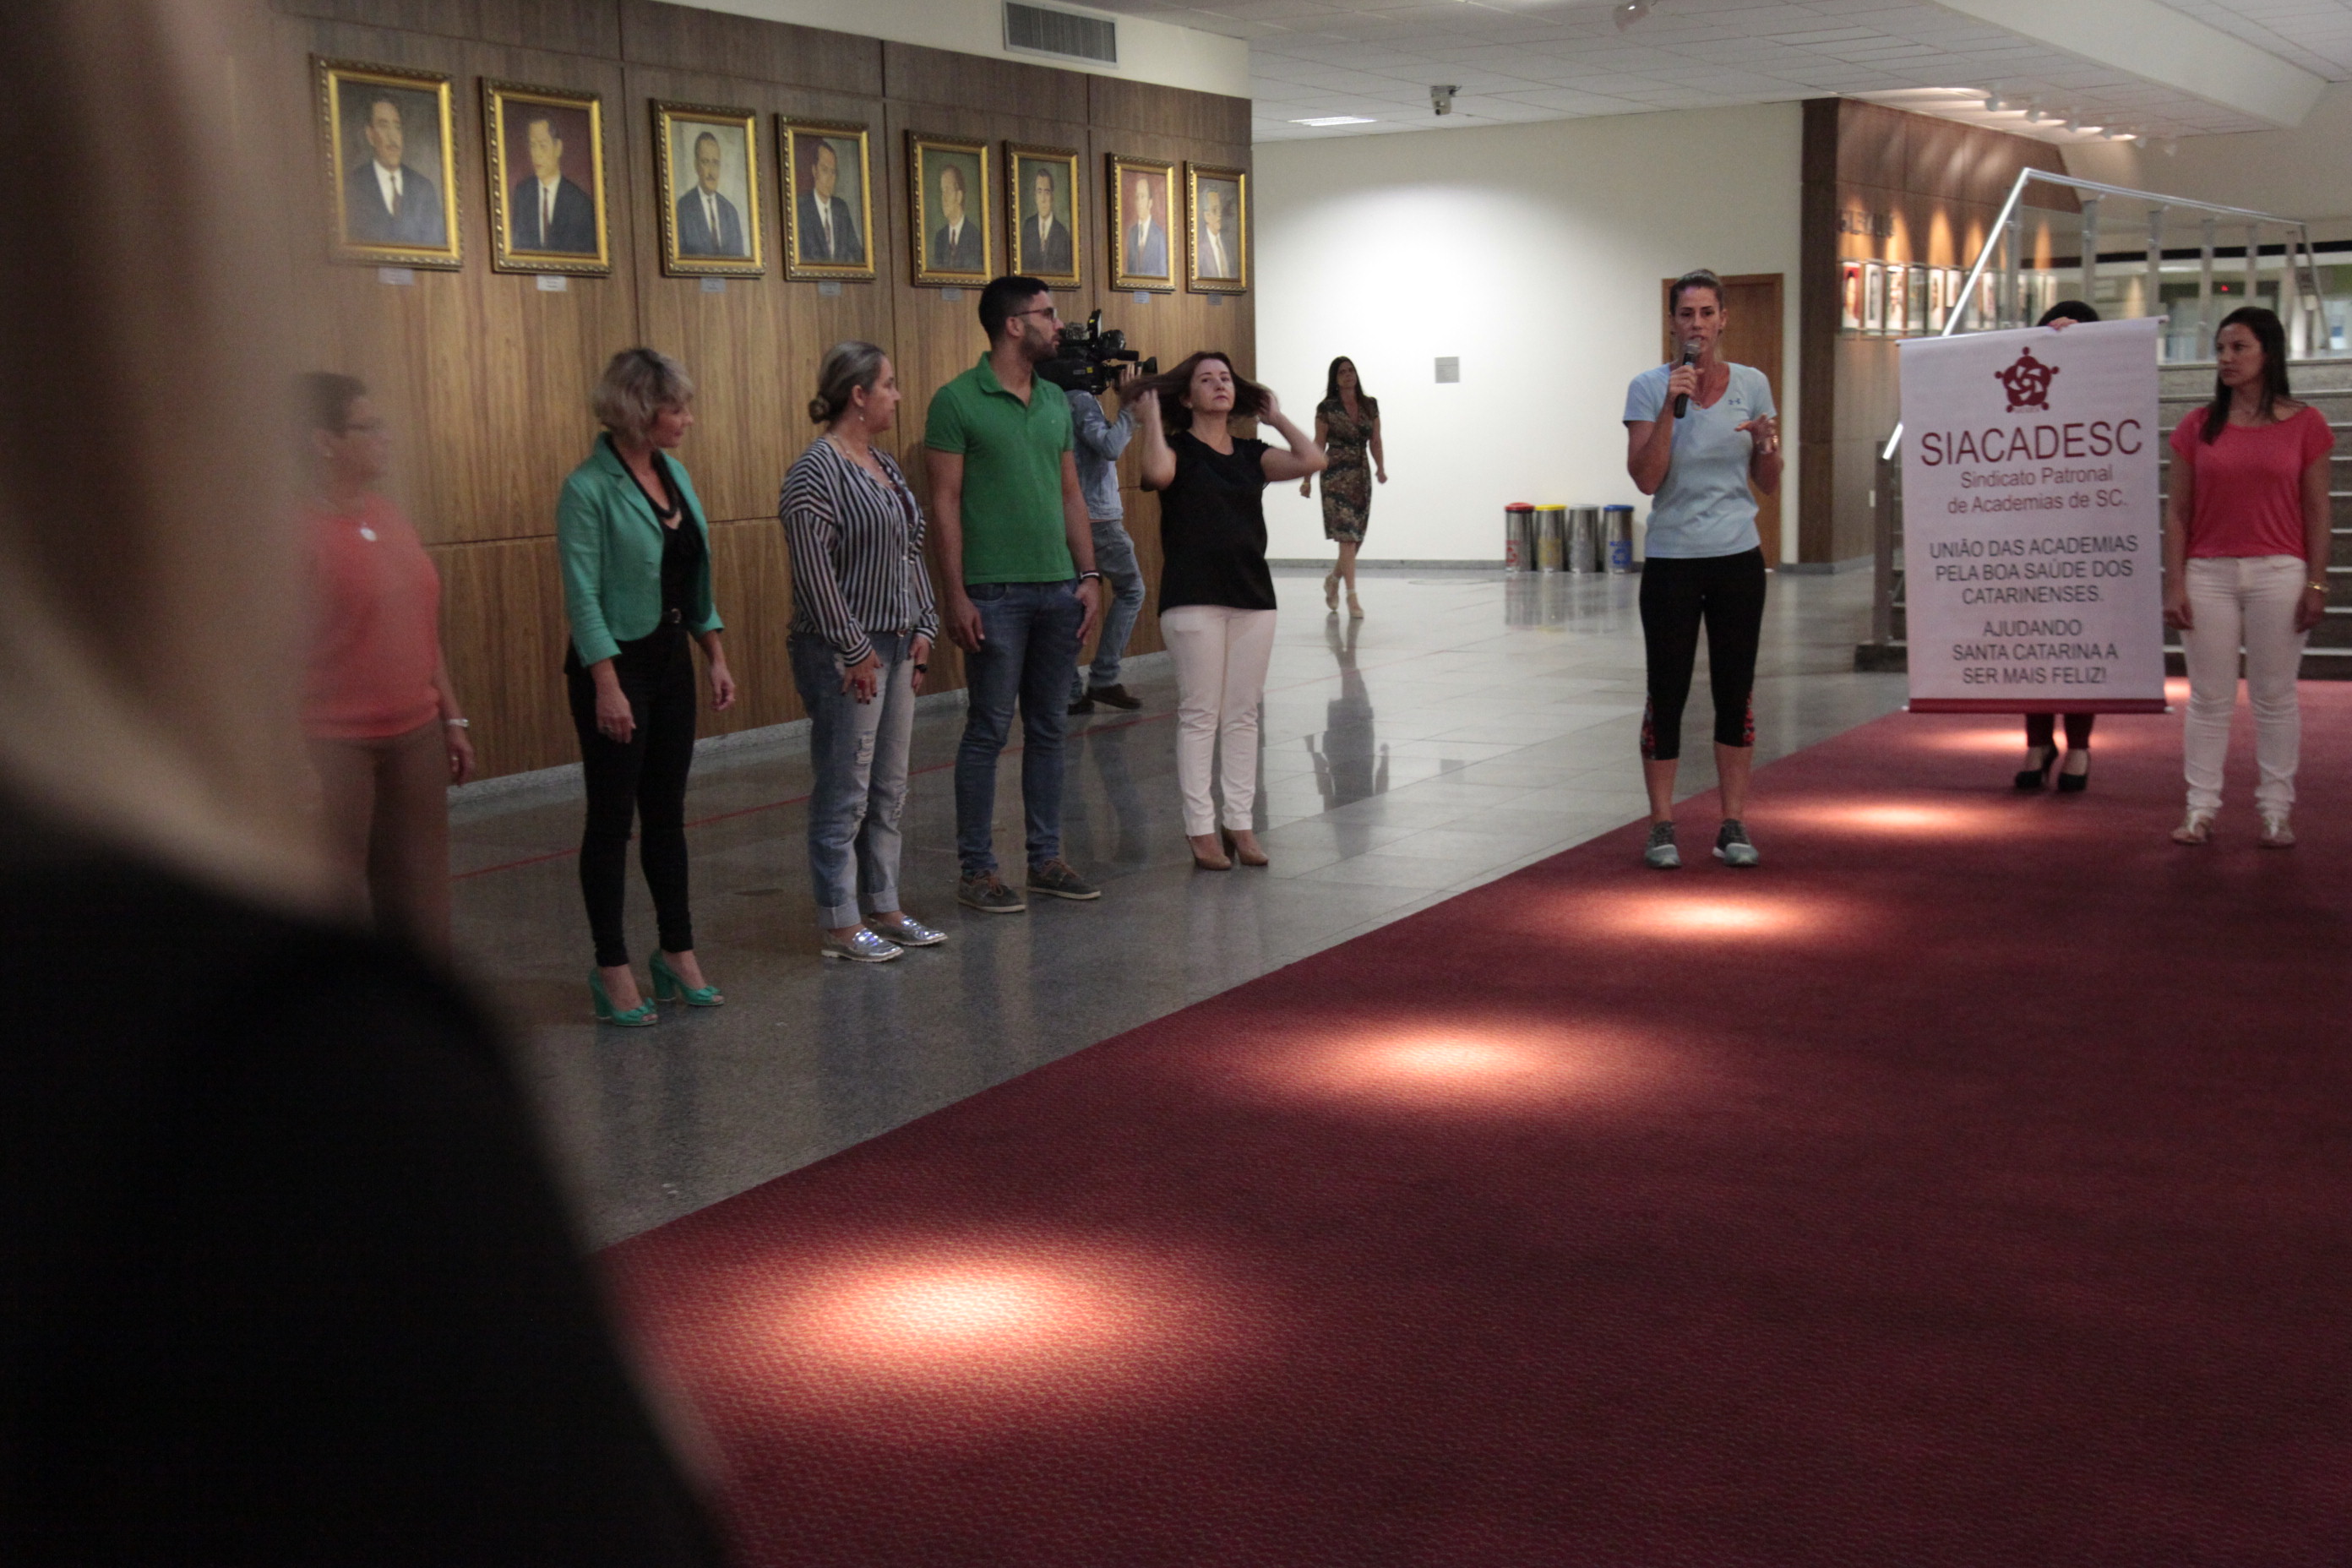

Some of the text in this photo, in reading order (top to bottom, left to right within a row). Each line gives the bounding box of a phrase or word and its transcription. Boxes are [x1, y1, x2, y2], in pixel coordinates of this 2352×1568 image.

[1921, 419, 2142, 466] SIACADESC
[1961, 465, 2113, 489] Sindicato Patronal
[1947, 497, 1968, 514] de
[1972, 493, 2063, 513] Academias
[2069, 491, 2090, 509] de
[1930, 535, 2139, 559] UNIÃO DAS ACADEMIAS
[1936, 558, 2133, 581] PELA BOA SAÚDE DOS
[1984, 619, 2082, 637] AJUDANDO
[1952, 642, 2119, 662] SANTA CATARINA A
[1963, 668, 1999, 684] SER
[2003, 667, 2047, 684] MAIS
